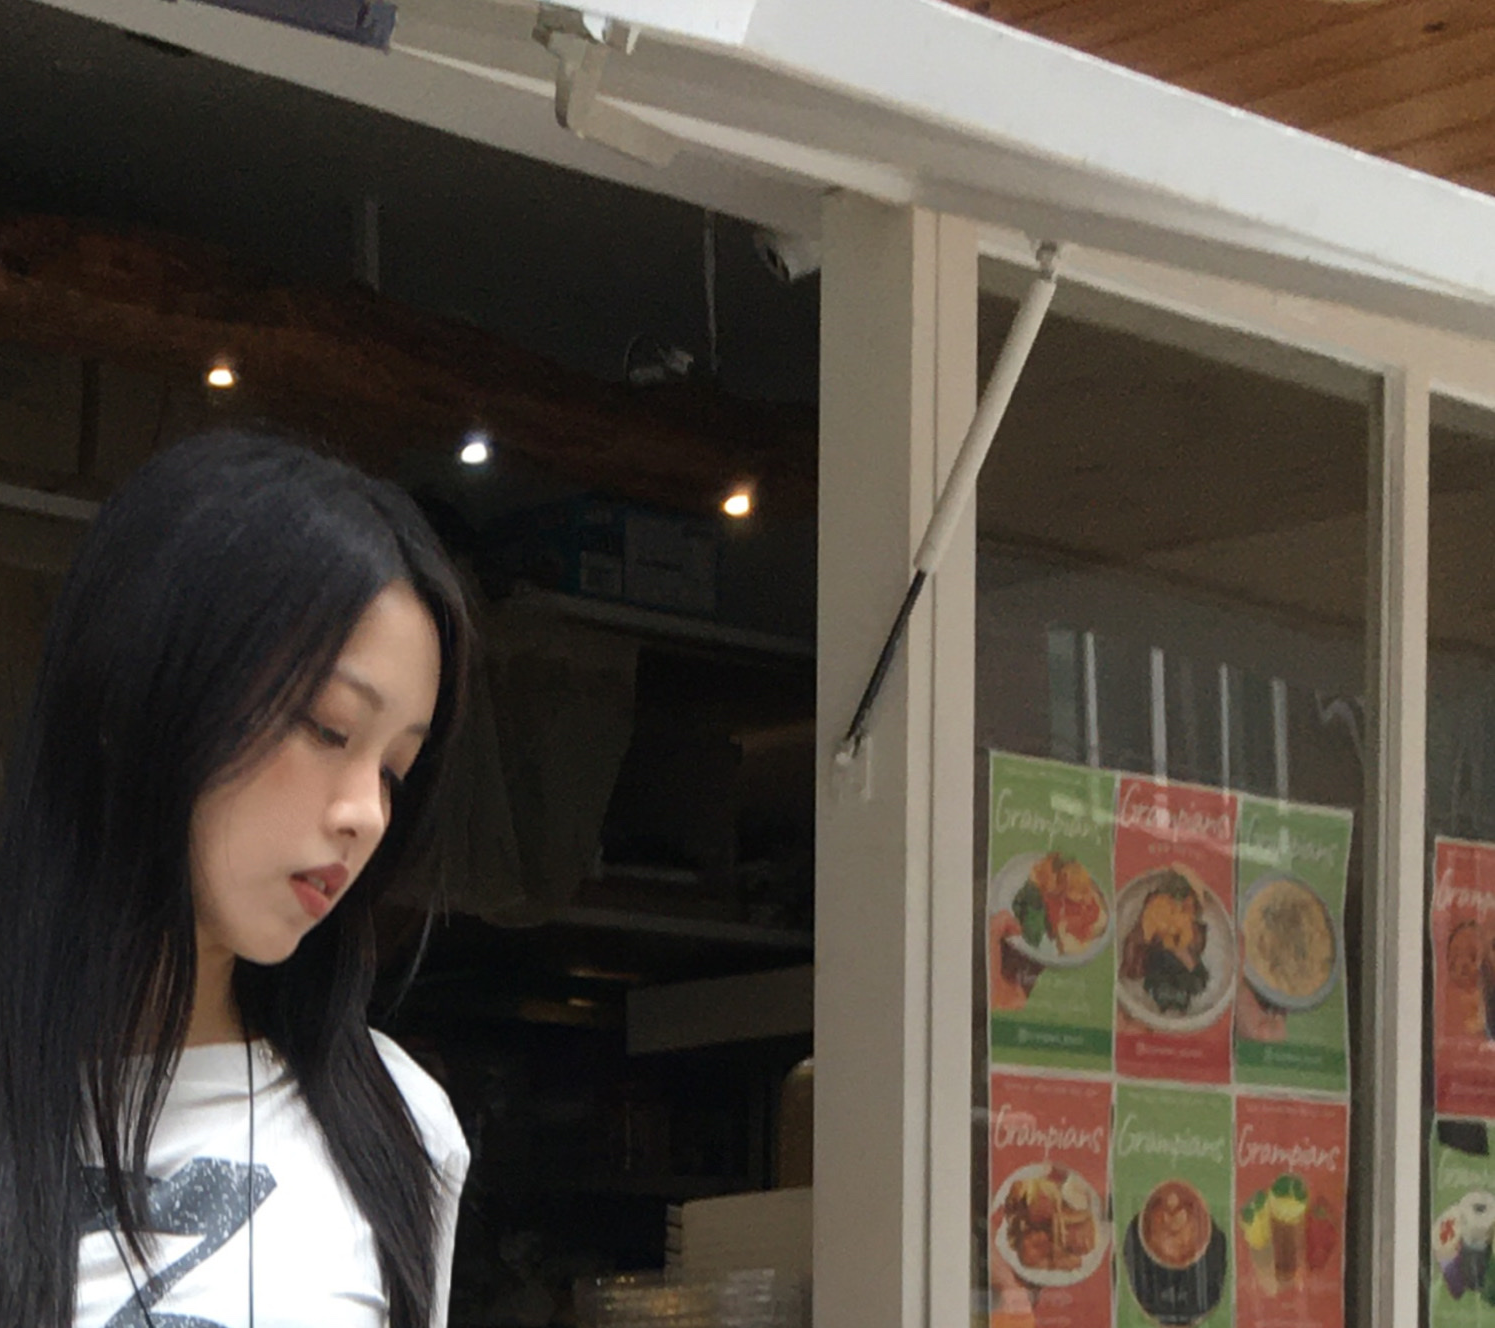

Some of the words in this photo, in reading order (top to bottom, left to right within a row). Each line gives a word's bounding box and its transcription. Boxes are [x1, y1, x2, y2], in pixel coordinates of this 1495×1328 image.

[994, 1103, 1104, 1161] Grampians
[1118, 1113, 1226, 1169] Grampians
[1237, 1123, 1341, 1173] Grampians
